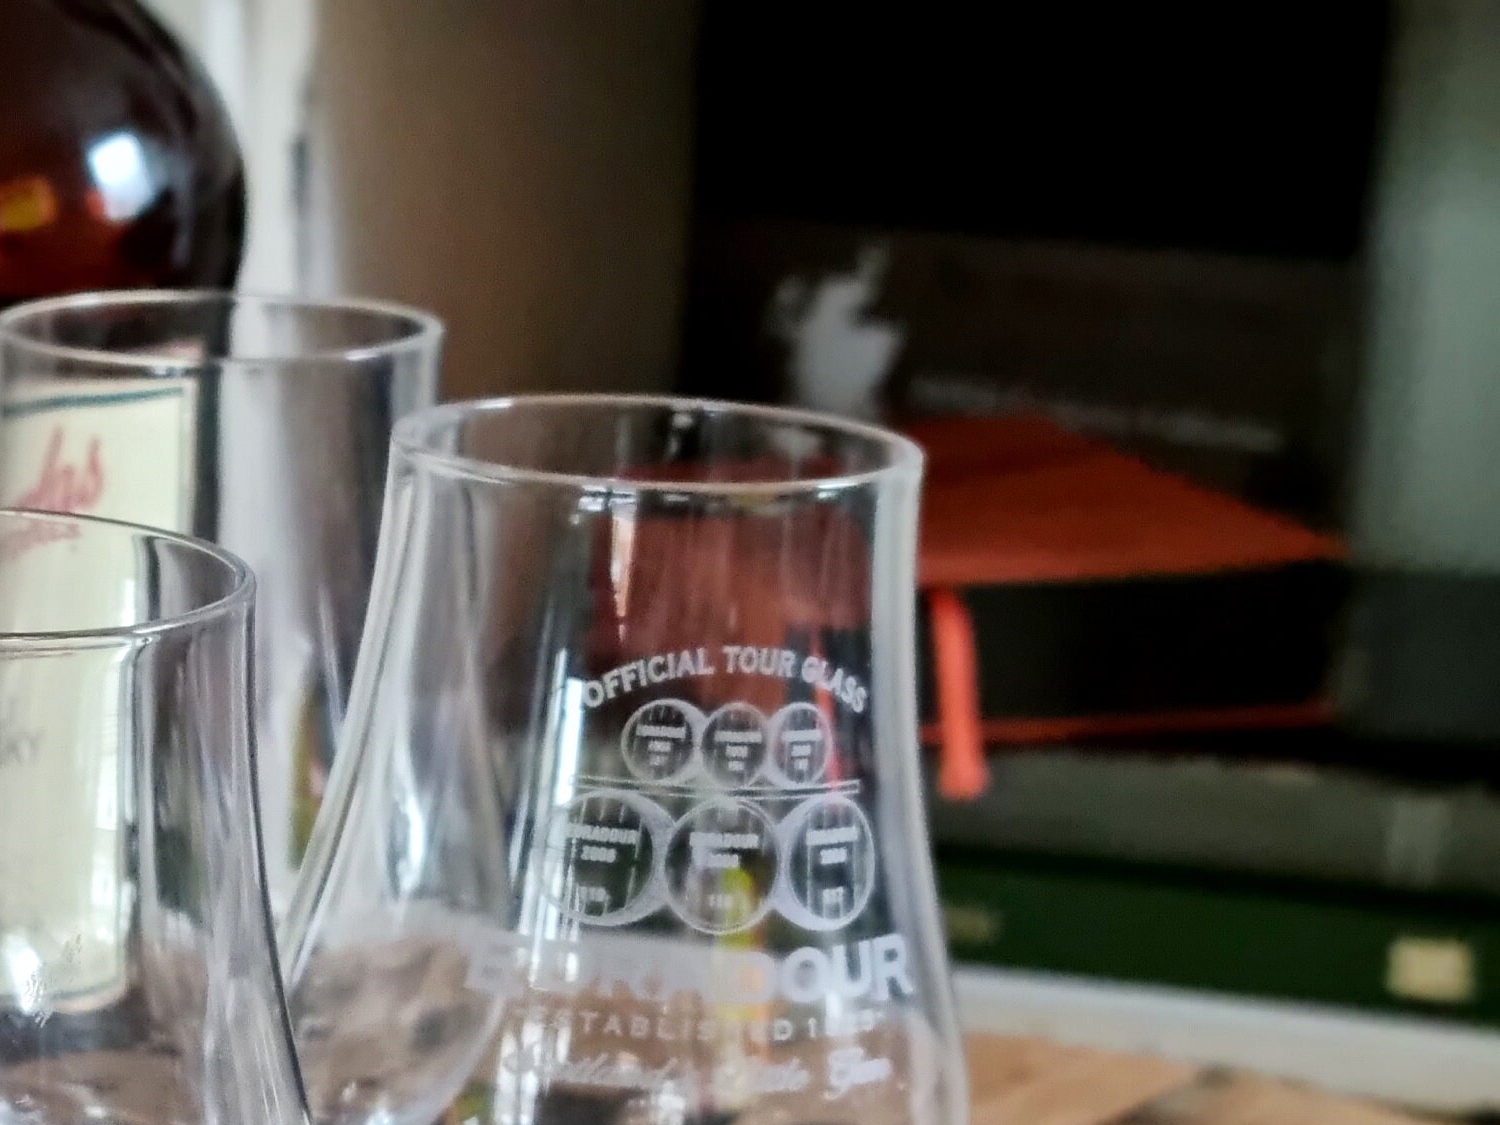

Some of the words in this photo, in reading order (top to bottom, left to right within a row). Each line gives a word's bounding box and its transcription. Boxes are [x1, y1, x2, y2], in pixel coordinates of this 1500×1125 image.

[581, 648, 715, 708] OFFICIAL
[723, 645, 796, 678] TOUR
[801, 655, 868, 713] GLASS
